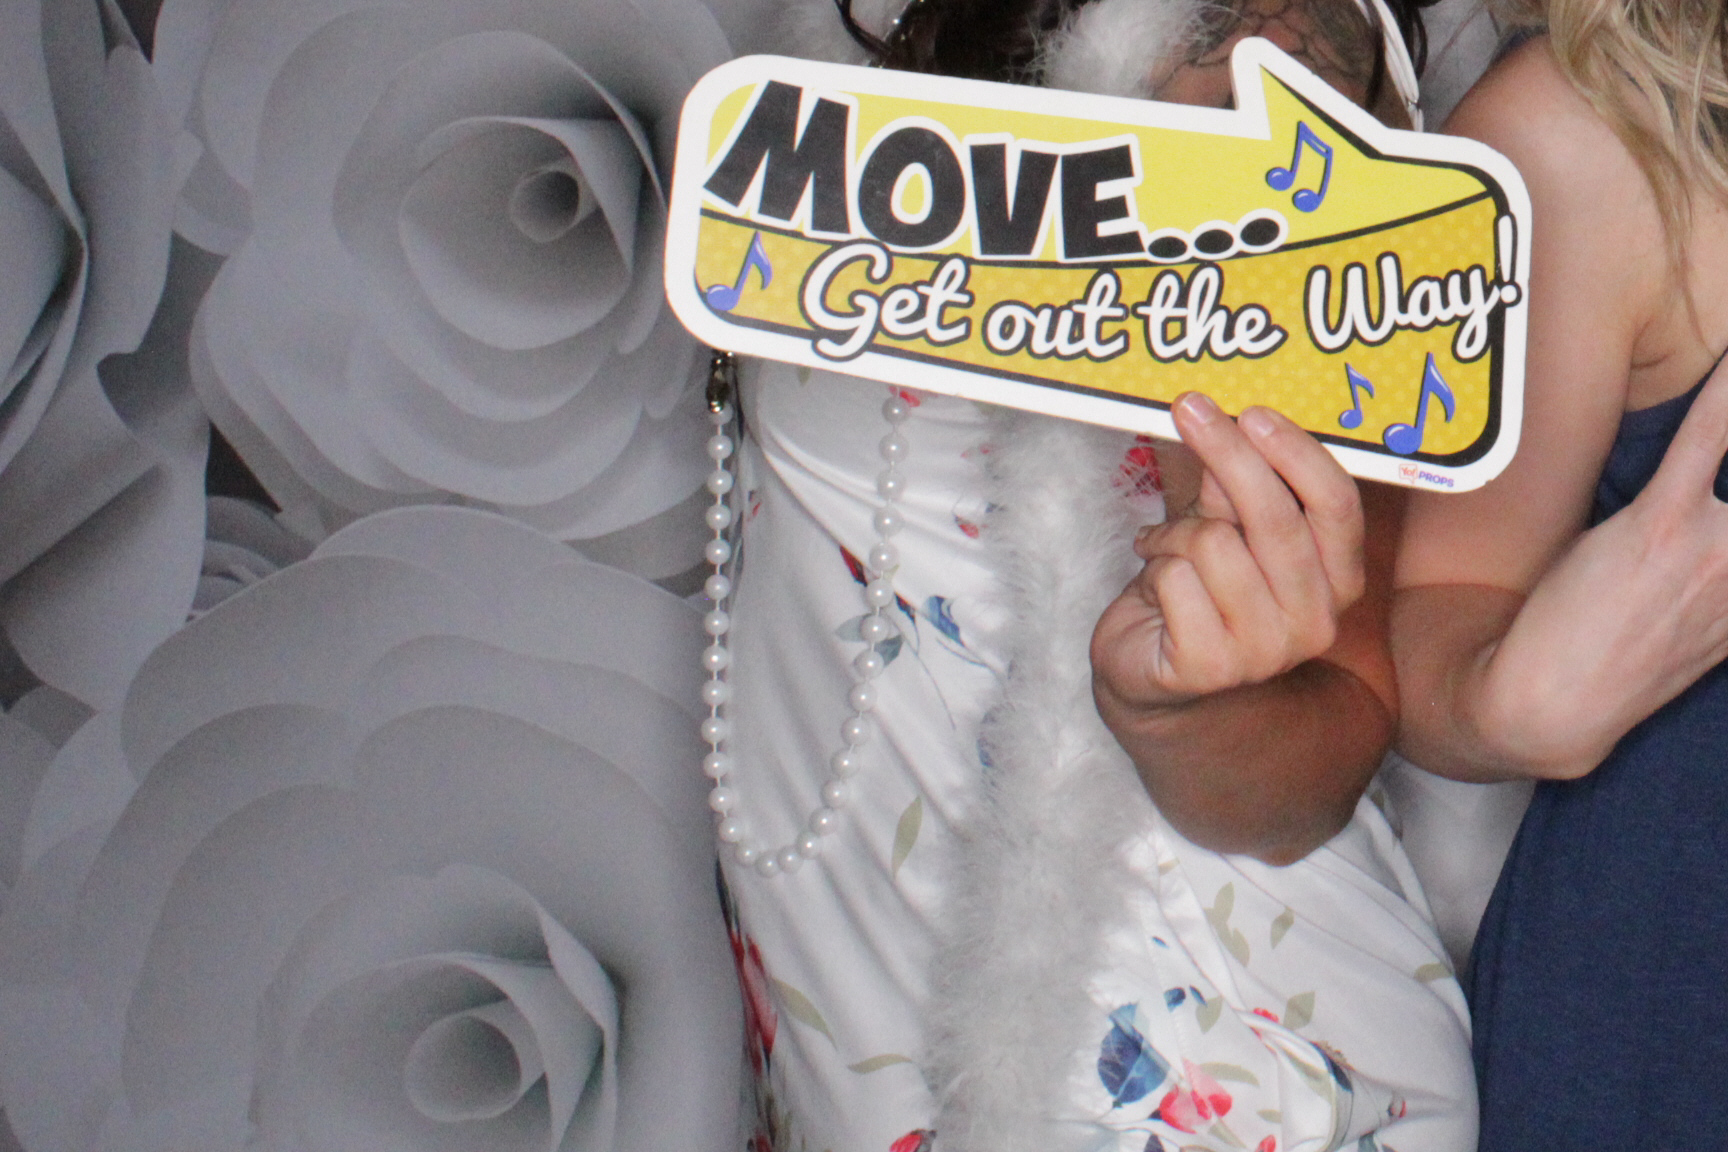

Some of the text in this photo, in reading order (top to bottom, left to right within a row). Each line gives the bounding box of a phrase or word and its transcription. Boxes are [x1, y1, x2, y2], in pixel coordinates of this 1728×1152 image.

[705, 80, 1281, 260] MOVE...
[803, 216, 1521, 360] Get out the Way!
[1418, 470, 1455, 488] PROPS
